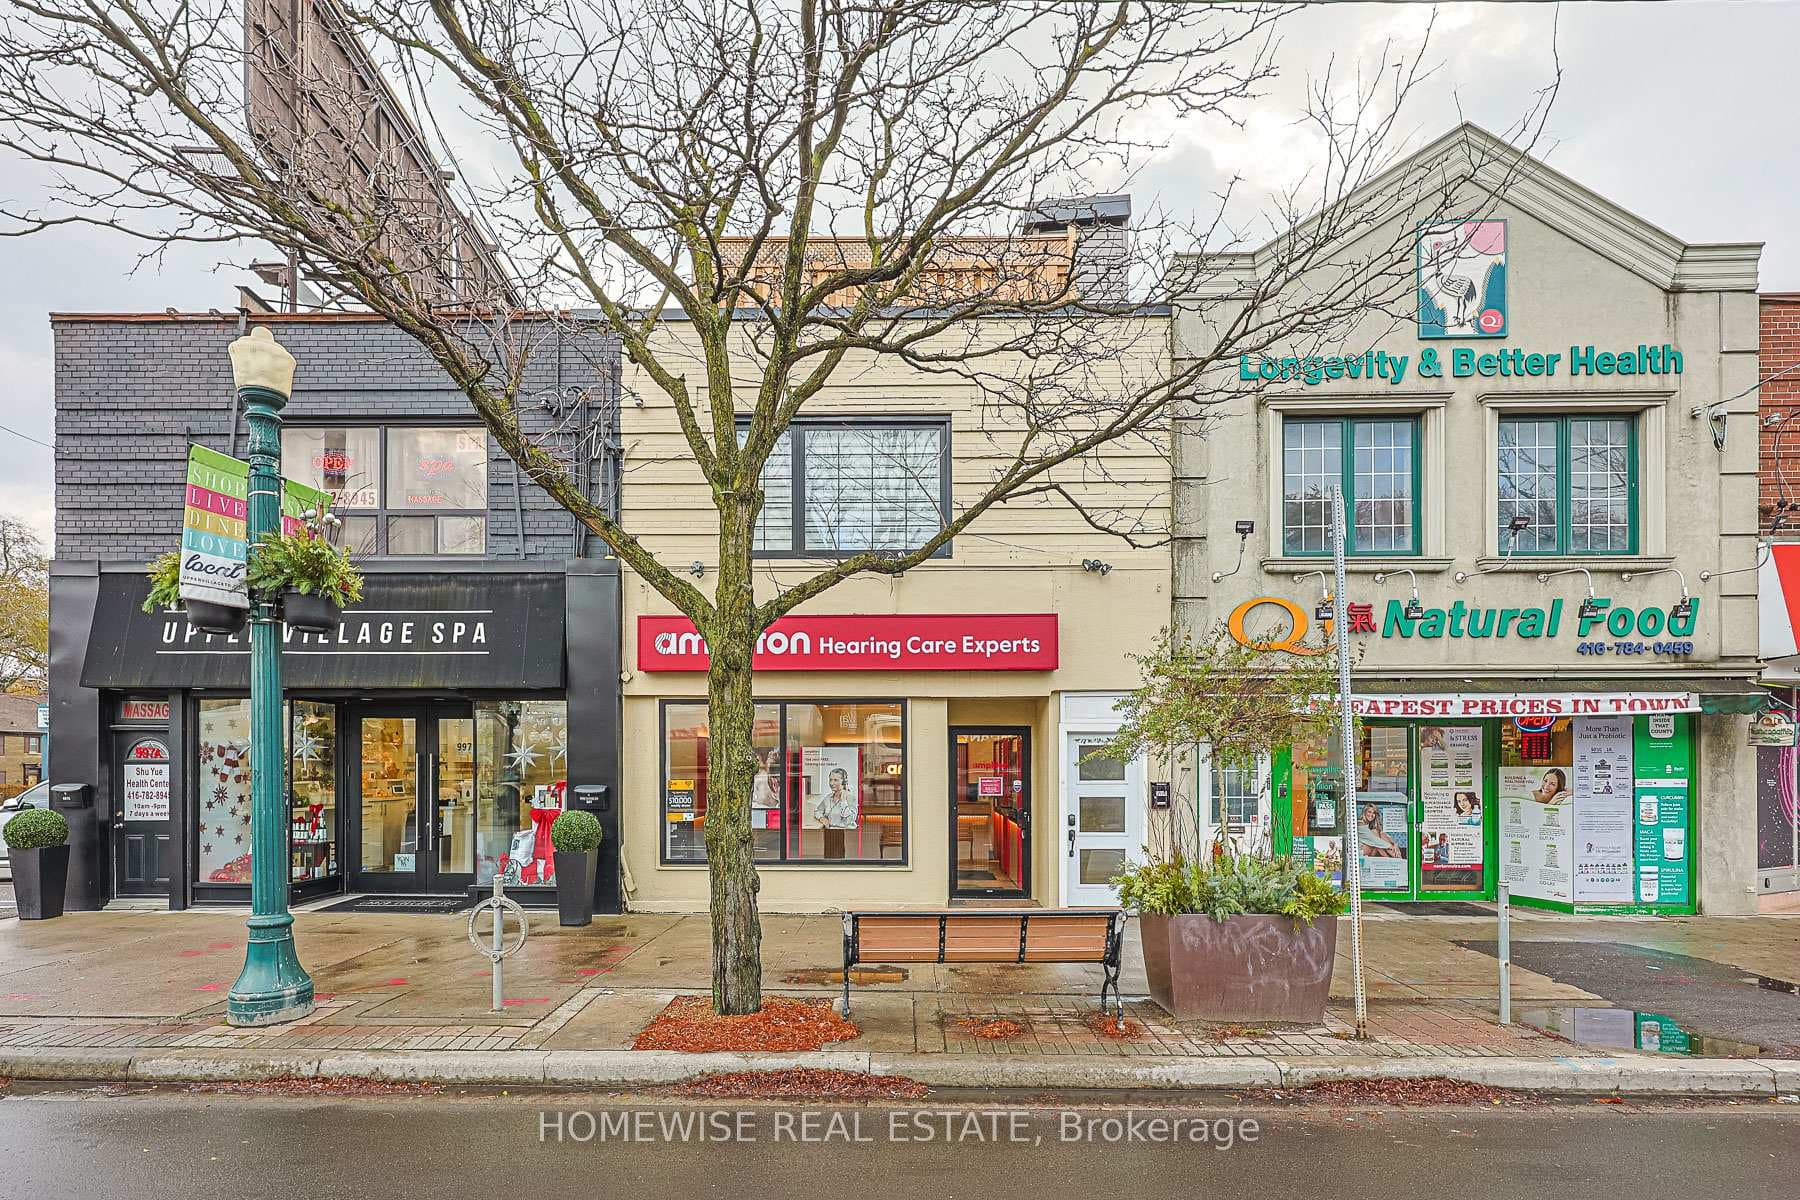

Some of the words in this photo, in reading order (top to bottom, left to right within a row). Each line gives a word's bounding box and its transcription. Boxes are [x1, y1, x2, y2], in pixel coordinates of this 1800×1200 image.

[1239, 350, 1409, 385] Longevity
[1418, 348, 1443, 377] &
[1452, 346, 1562, 378] Better
[1570, 344, 1684, 376] Health
[192, 469, 246, 496] SHOP
[191, 488, 244, 518] LIVE
[190, 511, 244, 538] DINE
[188, 532, 243, 559] LOVE
[185, 554, 245, 579] local
[1347, 602, 1377, 633] 氣
[1382, 598, 1564, 639] Natural
[1577, 598, 1700, 638] Food
[431, 622, 487, 644] SPA
[819, 637, 901, 658] Hearing
[906, 636, 957, 653] Care
[962, 636, 1041, 657] Experts
[1311, 699, 1453, 715] EAPEST
[1461, 699, 1562, 715] PRICES
[1571, 698, 1601, 714] IN
[1610, 698, 1691, 712] TOWN
[457, 743, 472, 751] 997
[126, 779, 148, 788] Health
[135, 767, 149, 776] Shu
[150, 767, 163, 776] Yue
